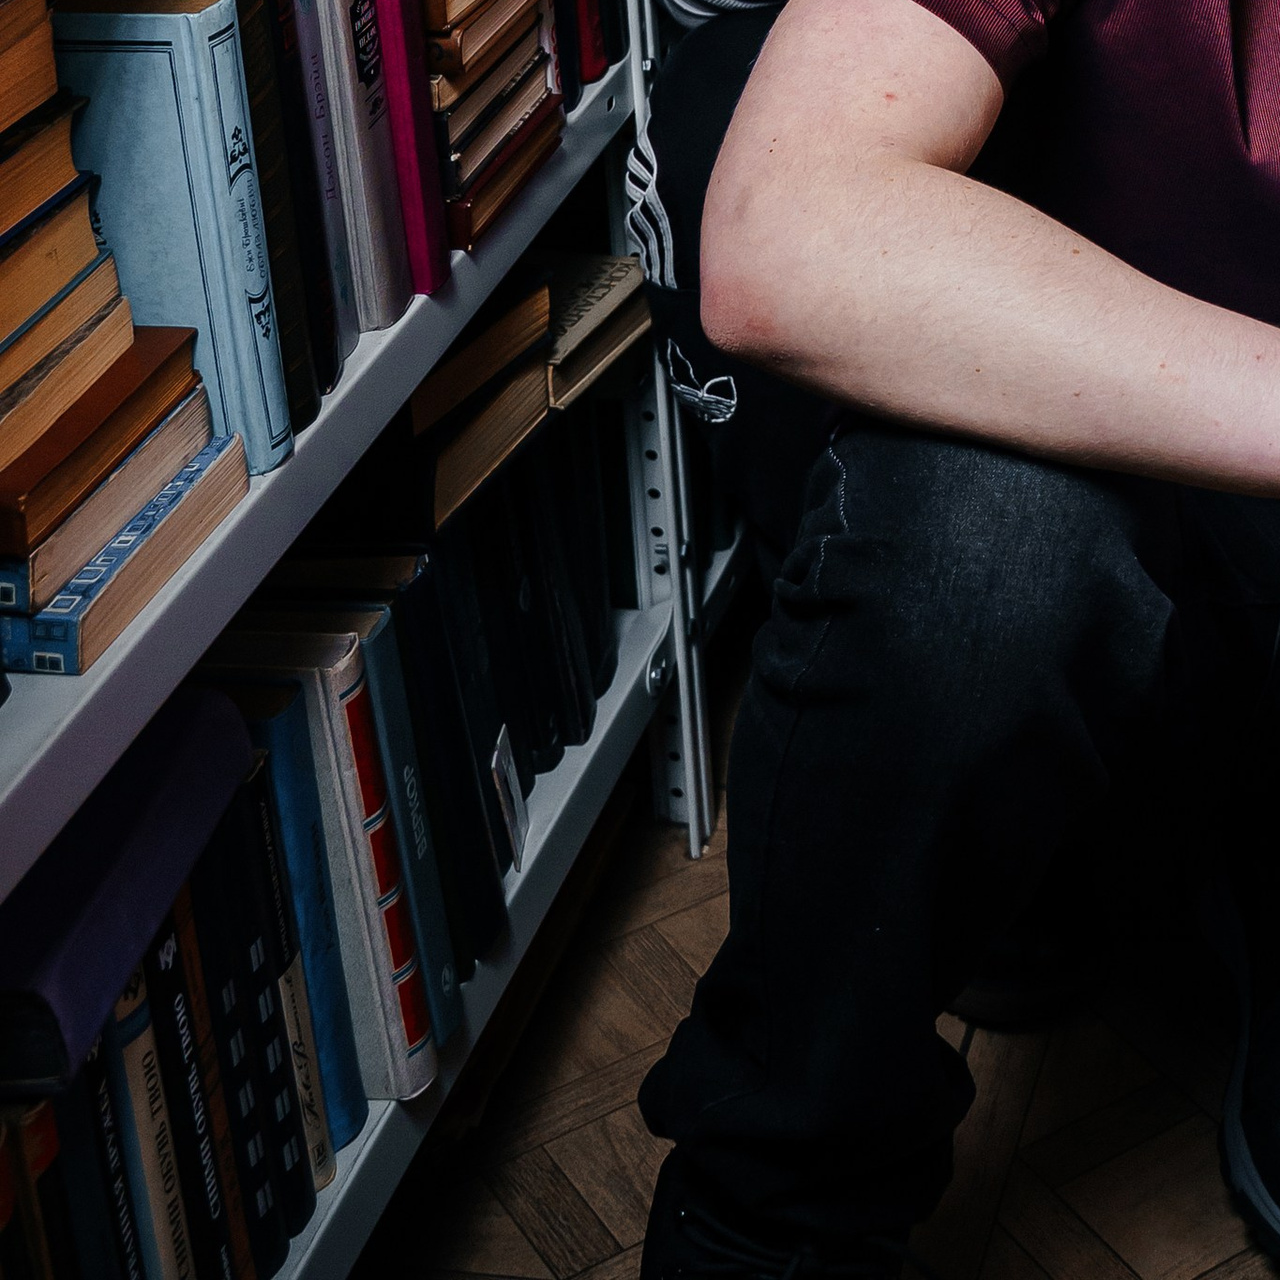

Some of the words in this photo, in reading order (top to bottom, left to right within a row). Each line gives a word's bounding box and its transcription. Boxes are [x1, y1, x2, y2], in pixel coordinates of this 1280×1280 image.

[311, 52, 327, 119] Брэйн
[325, 133, 340, 201] Джон
[173, 992, 190, 1065] ТВОЮ
[141, 1048, 163, 1122] ТВОЮ
[187, 1063, 205, 1135] ОБУВЬ
[199, 1135, 221, 1220] СНИМИ
